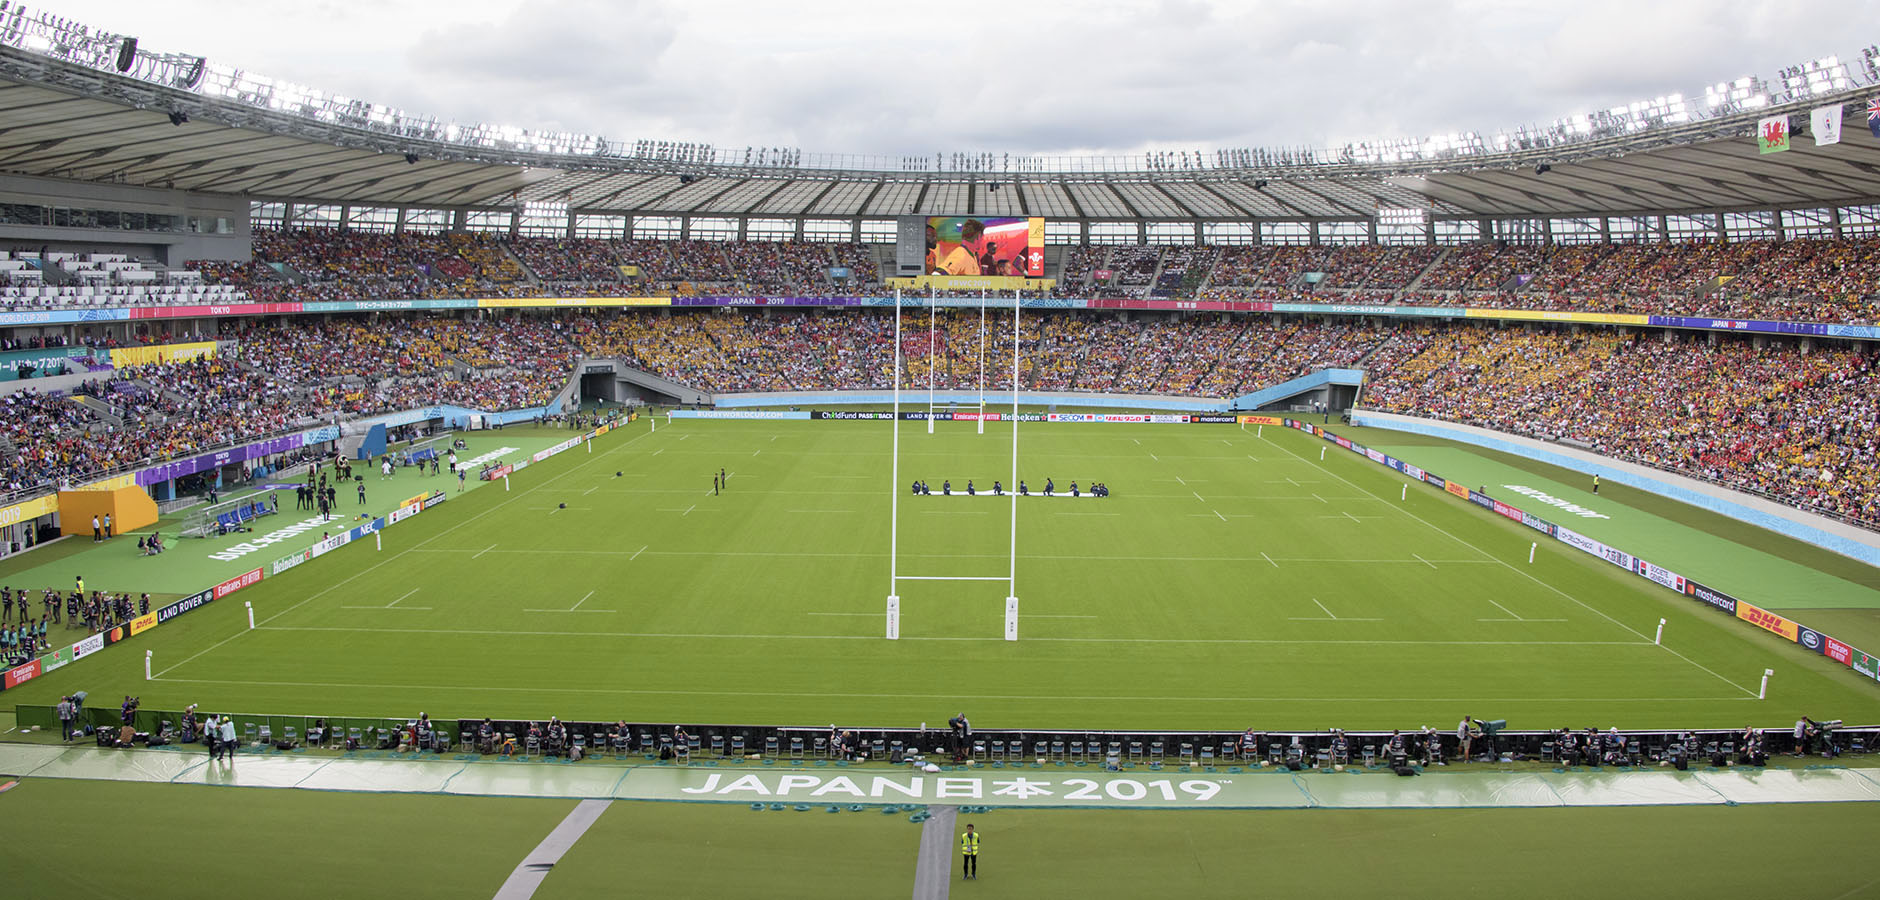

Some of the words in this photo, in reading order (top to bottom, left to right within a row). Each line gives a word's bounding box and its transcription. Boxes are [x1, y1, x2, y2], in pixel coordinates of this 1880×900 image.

[948, 279, 991, 287] #RWC2019
[767, 297, 785, 305] 2019
[210, 306, 230, 314] TOKYO
[1247, 416, 1275, 424] DHL
[360, 521, 375, 536] NEC
[273, 553, 304, 575] Heineken
[218, 579, 241, 596] Emirates
[1695, 588, 1735, 612] mastercard
[158, 605, 178, 622] LAND
[180, 595, 203, 613] ROVER
[136, 616, 153, 629] DHL
[1748, 607, 1785, 634] DHL
[1828, 640, 1849, 656] Emirates
[13, 665, 35, 678] Emirates
